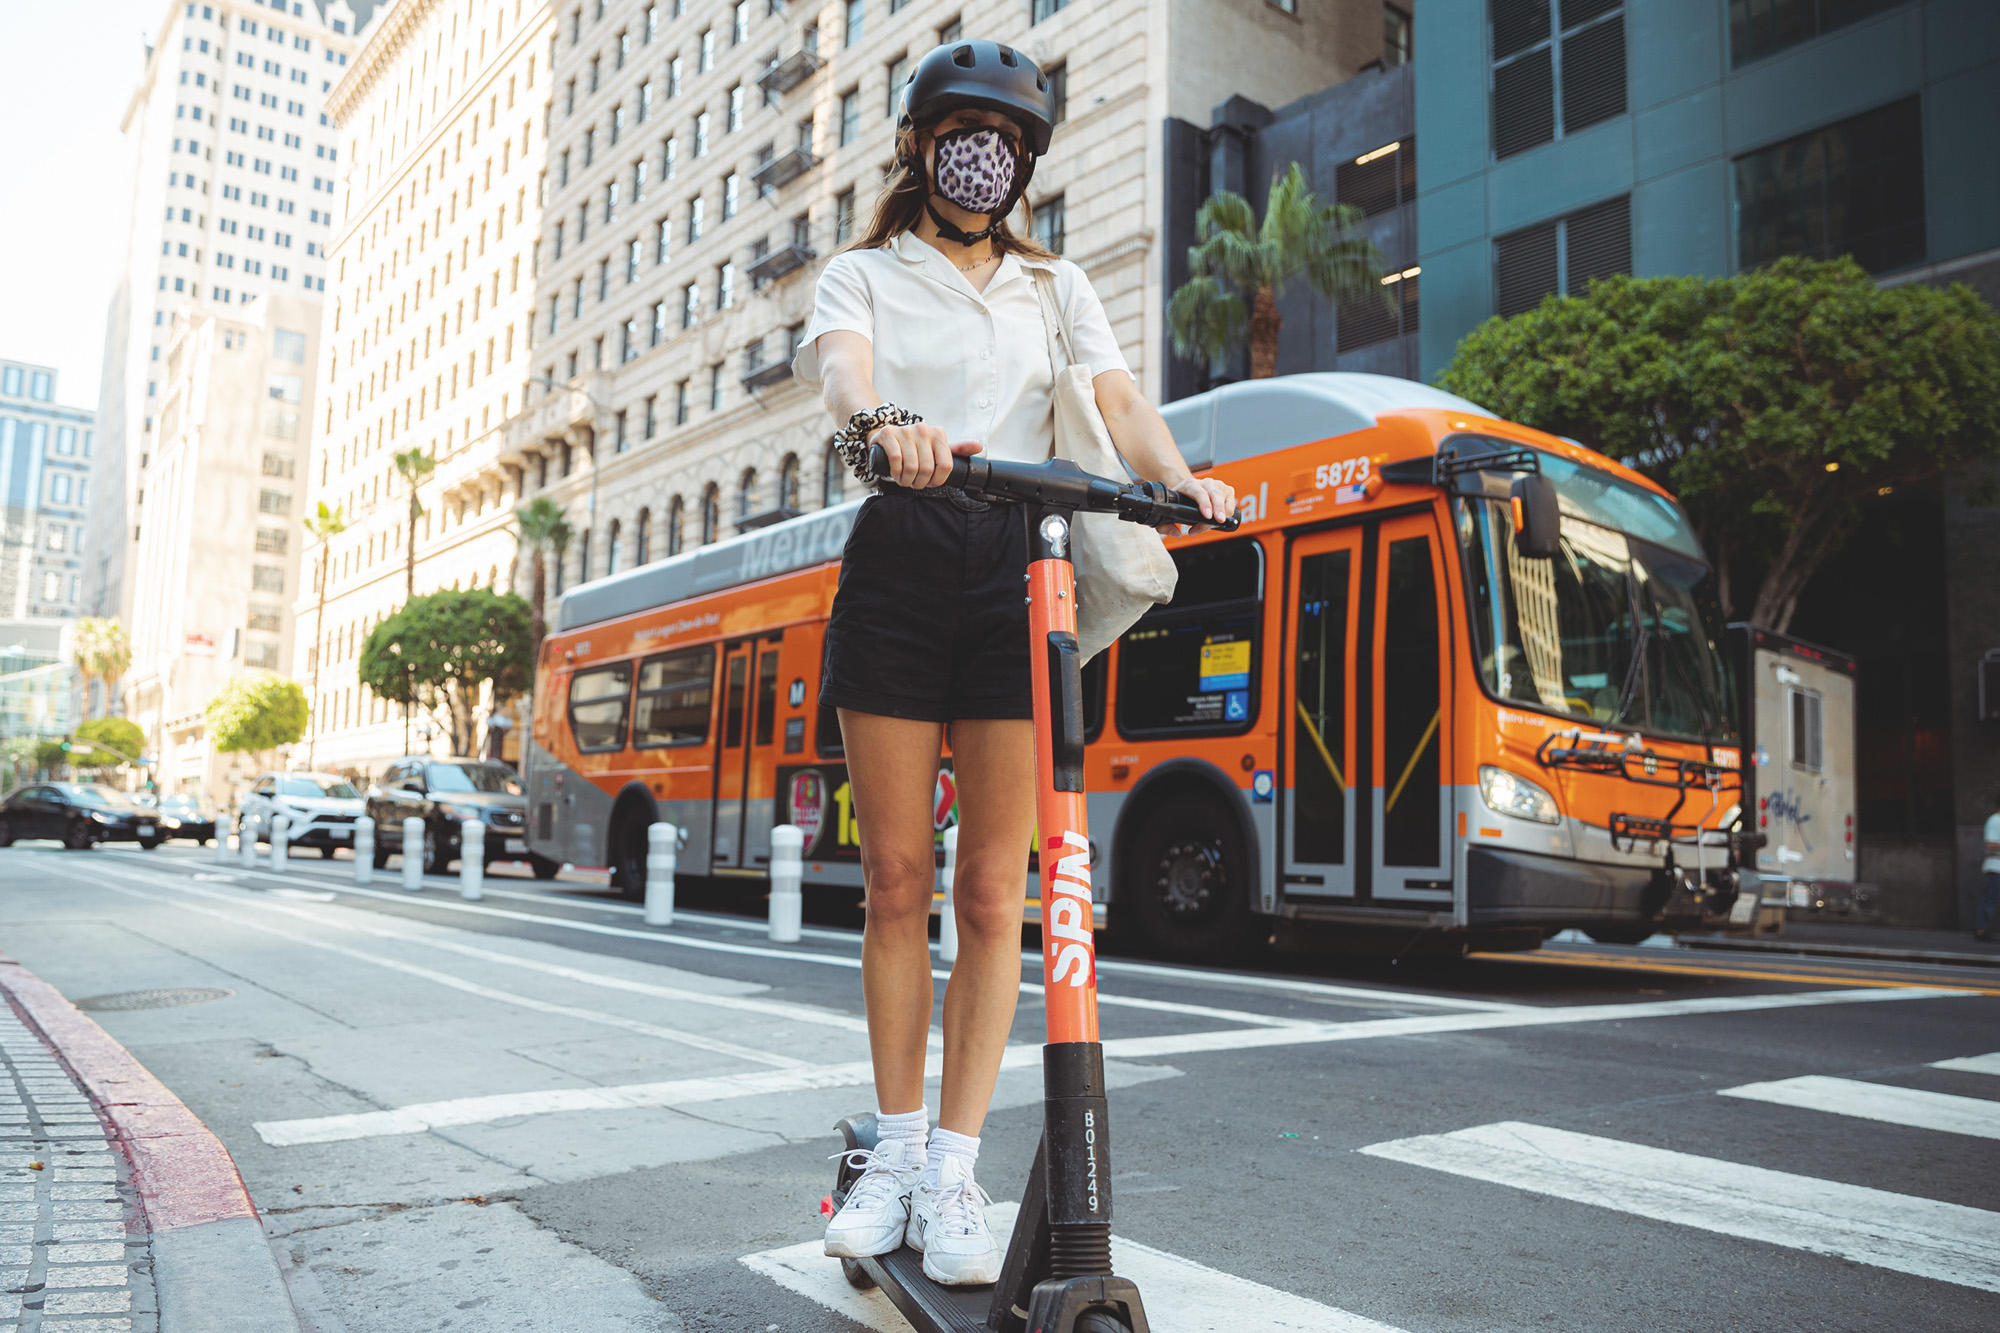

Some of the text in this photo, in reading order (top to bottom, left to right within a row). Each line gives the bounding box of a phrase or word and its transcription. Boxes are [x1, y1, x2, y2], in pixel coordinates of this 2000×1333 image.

[1315, 456, 1370, 490] 5873
[739, 513, 850, 580] Metro
[1050, 830, 1092, 987] SPIN
[1084, 1112, 1098, 1212] B01249
